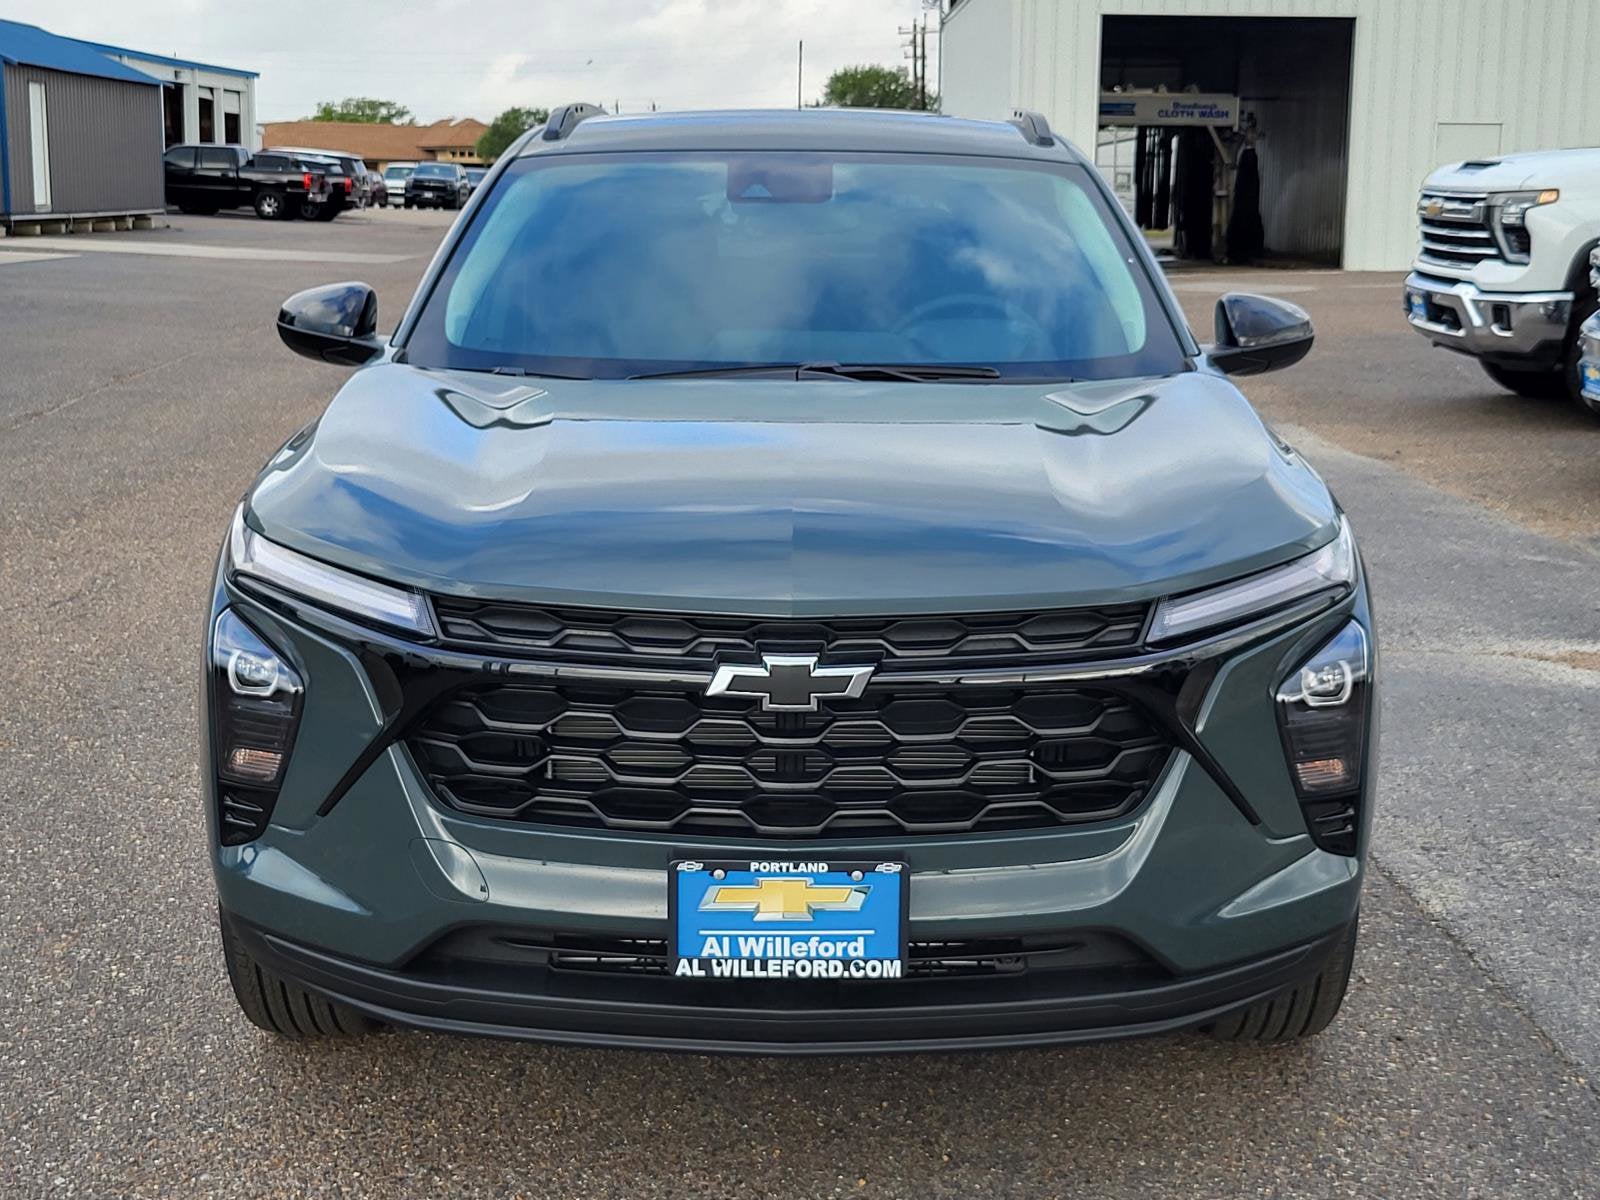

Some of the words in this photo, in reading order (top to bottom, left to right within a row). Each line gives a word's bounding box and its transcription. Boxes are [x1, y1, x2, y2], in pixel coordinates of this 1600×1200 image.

[1158, 109, 1194, 118] CLOTH
[1199, 109, 1229, 118] WASH
[750, 862, 829, 873] PORTLAND
[700, 937, 730, 957] Al
[737, 936, 865, 957] Willeford
[675, 959, 705, 977] AL
[711, 958, 901, 978] WILLEFORD.COM
